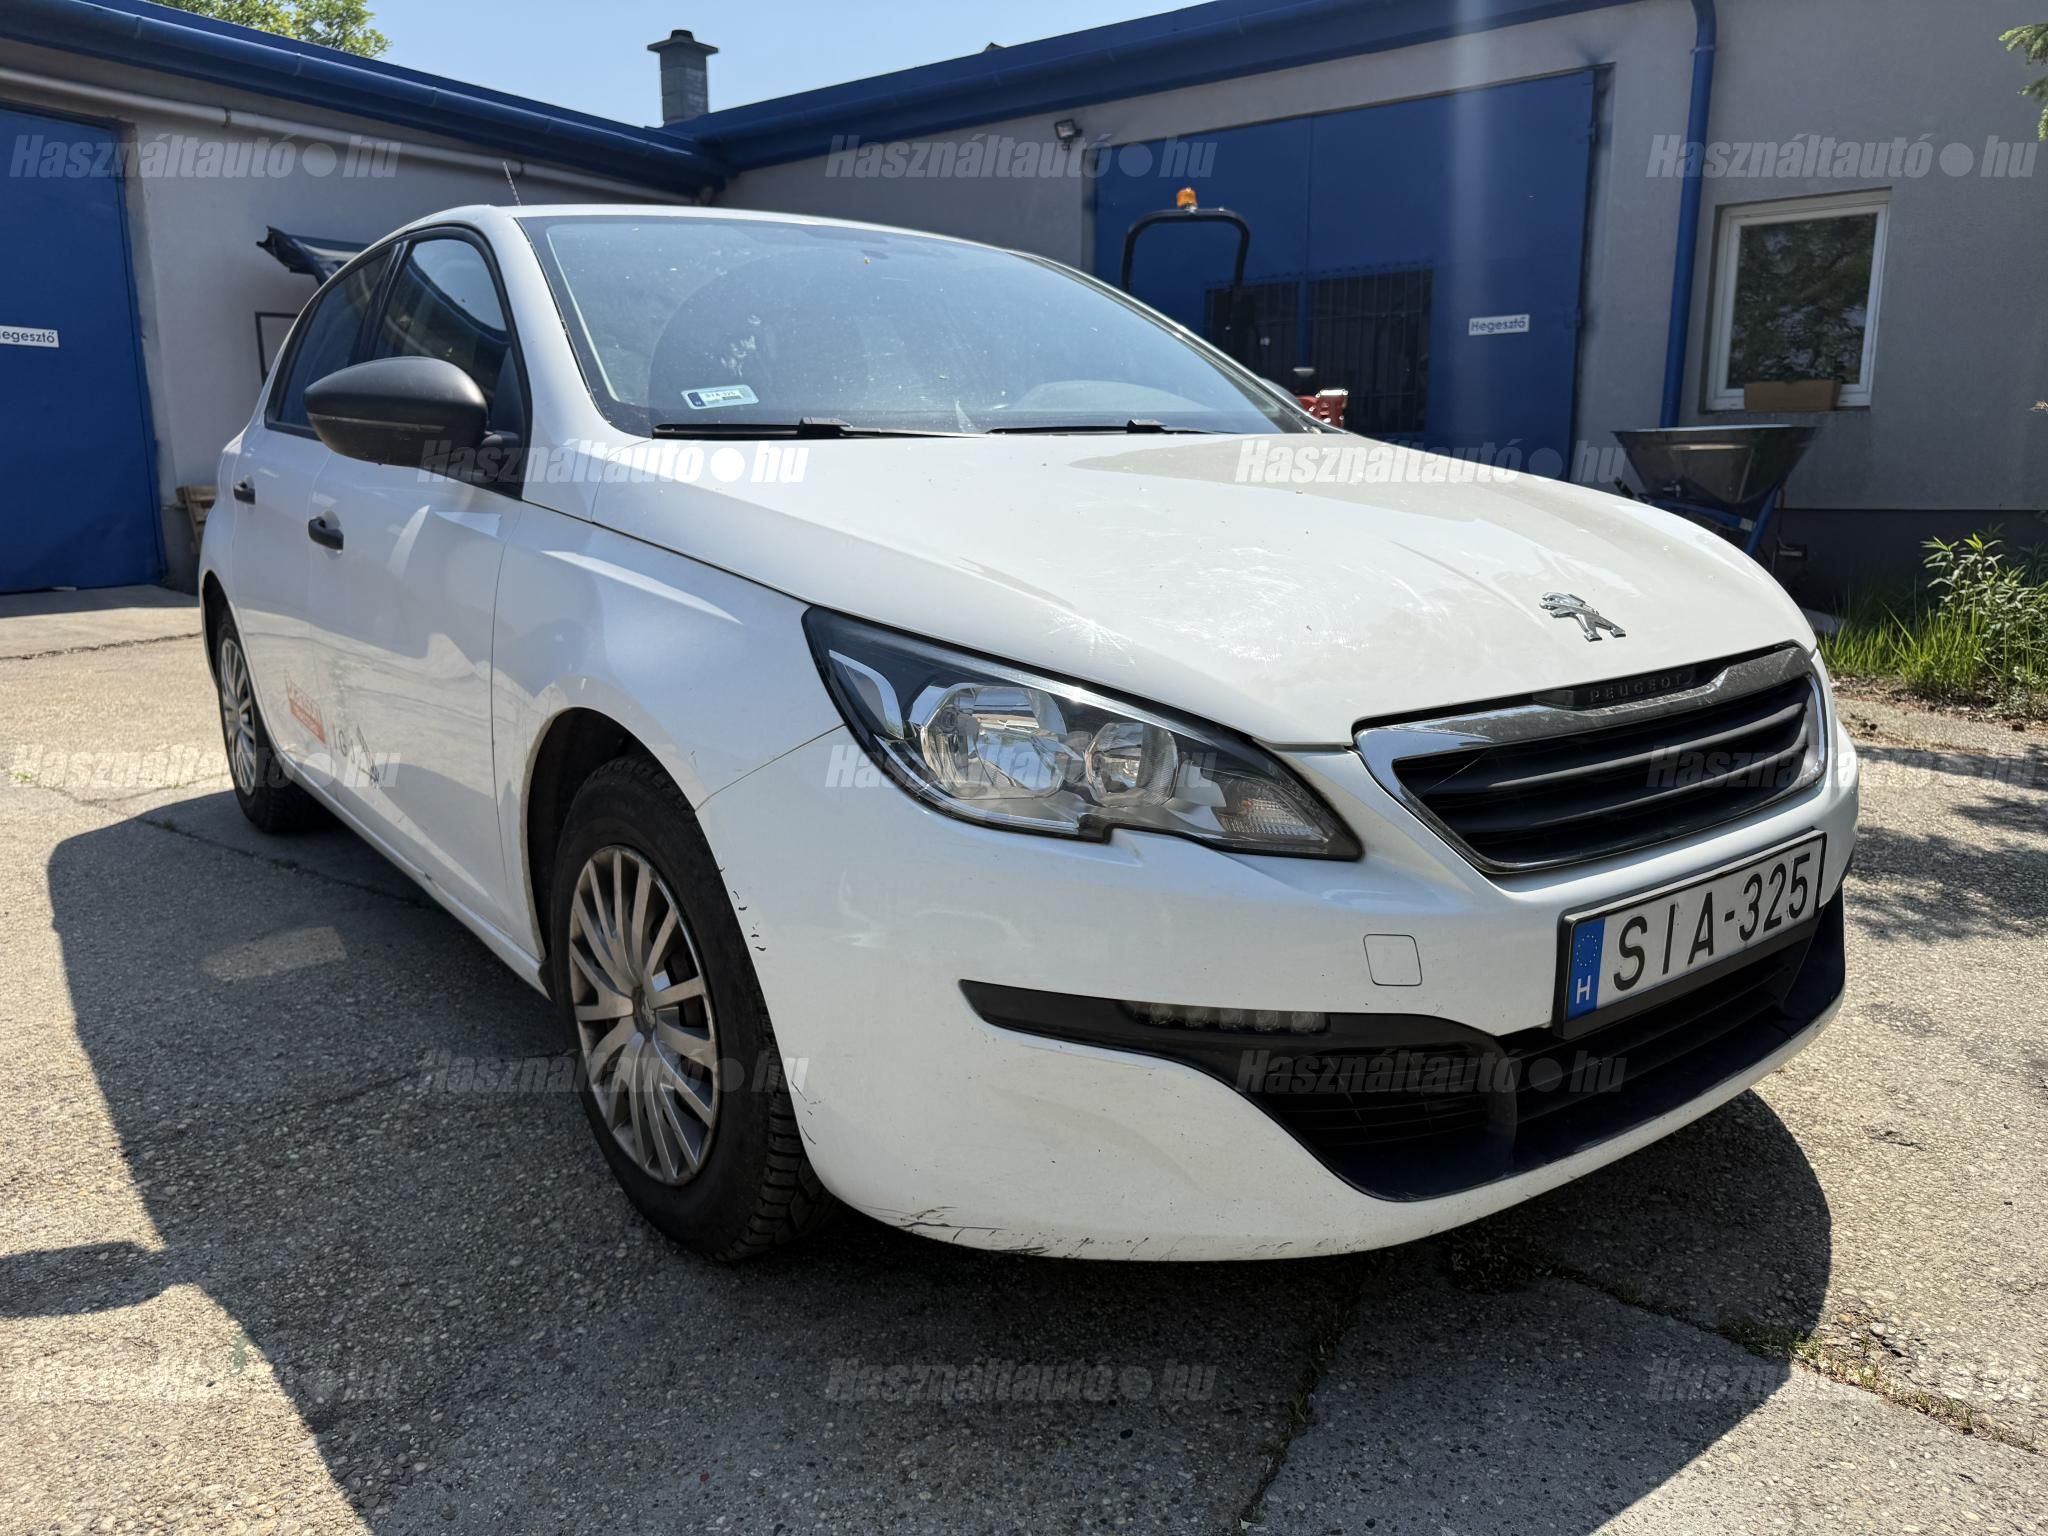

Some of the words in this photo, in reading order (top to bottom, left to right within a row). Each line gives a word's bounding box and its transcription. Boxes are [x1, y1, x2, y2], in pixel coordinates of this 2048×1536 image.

[1472, 316, 1527, 333] Hegesztő
[0, 331, 55, 343] egesztő
[1590, 673, 1681, 700] PEUGEOT
[1576, 974, 1592, 1006] H
